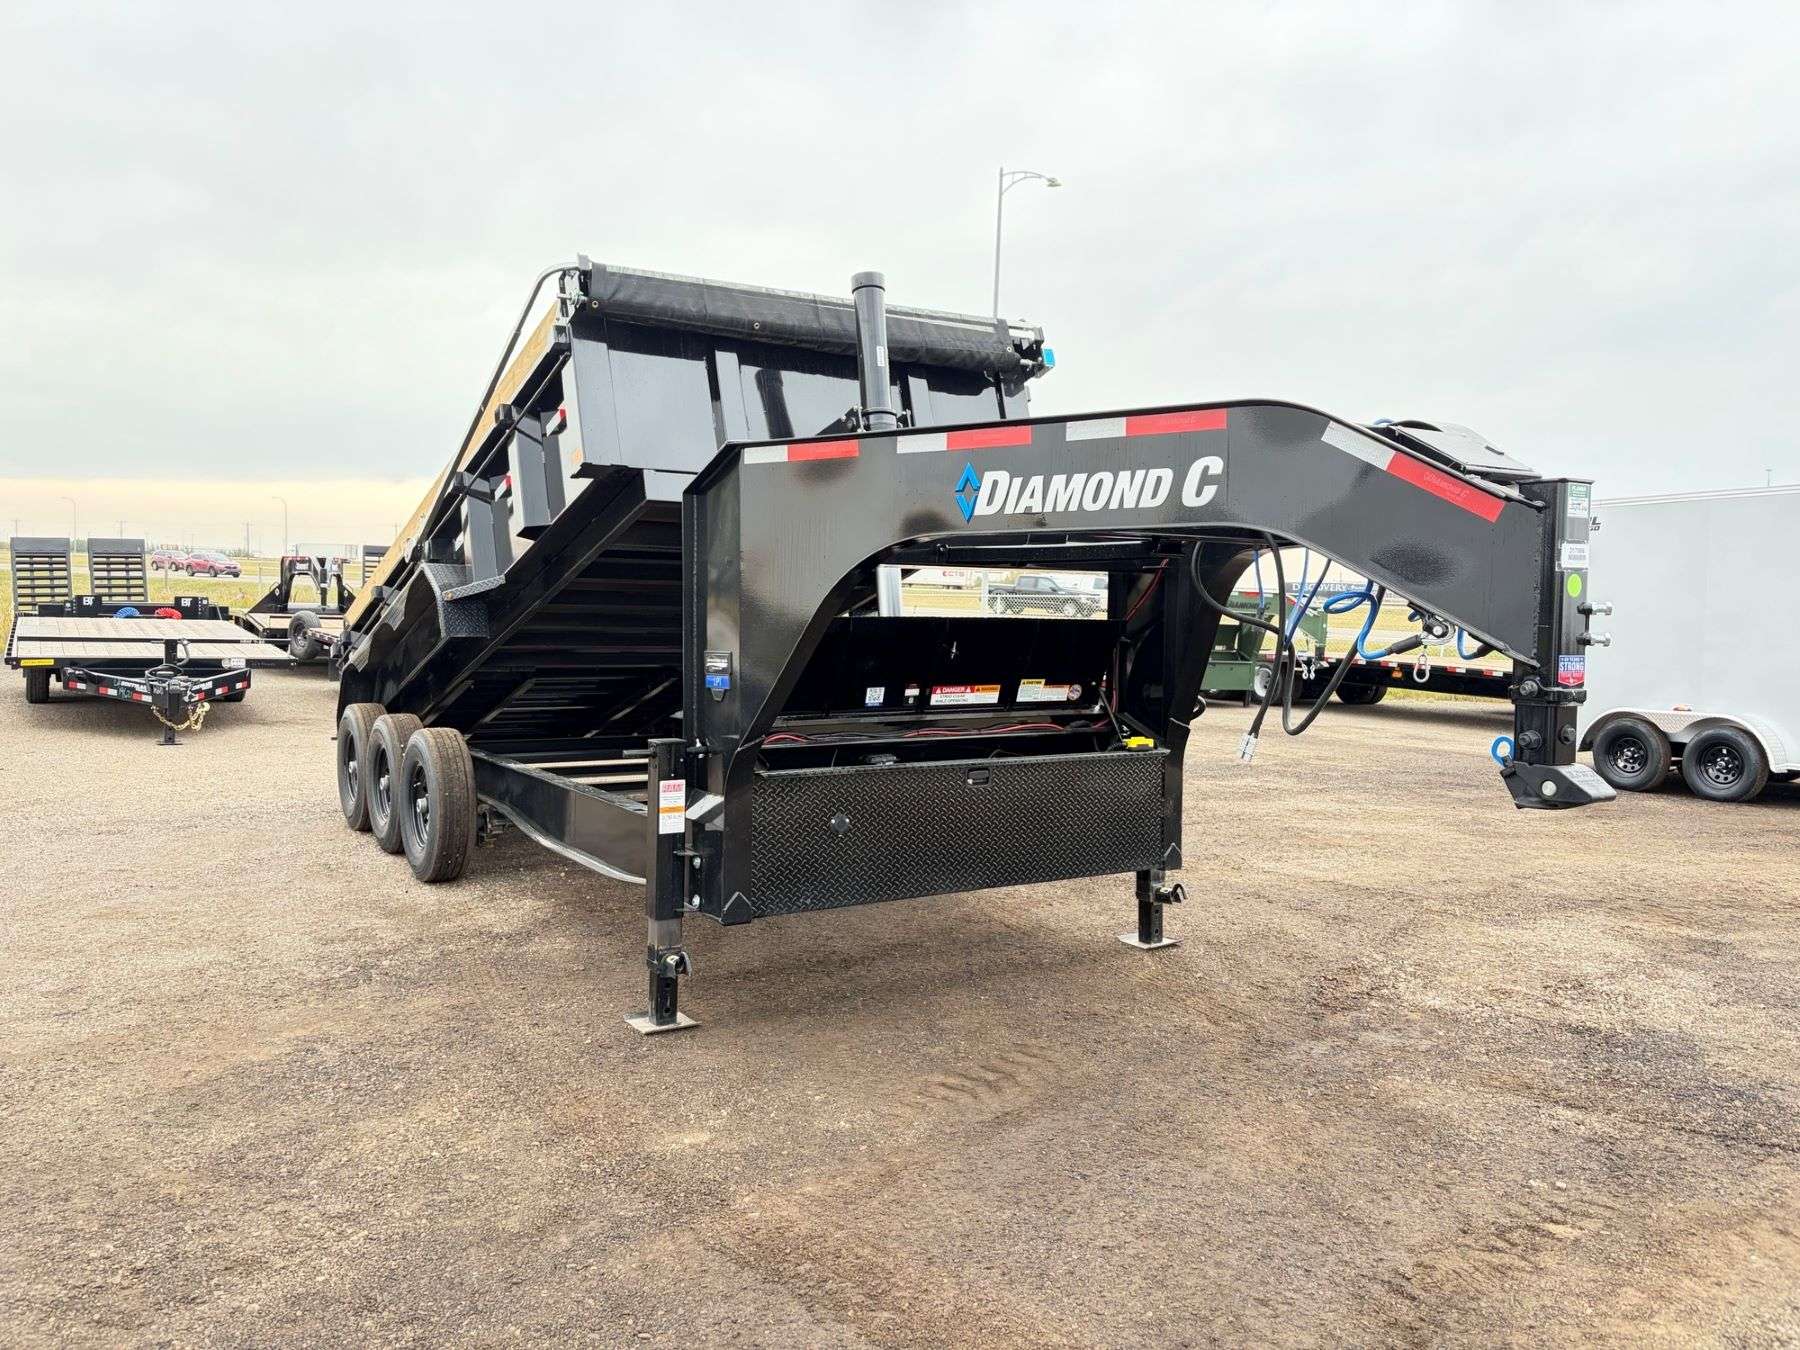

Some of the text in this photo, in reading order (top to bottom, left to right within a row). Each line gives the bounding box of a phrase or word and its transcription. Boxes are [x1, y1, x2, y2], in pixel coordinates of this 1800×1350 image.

[973, 456, 1224, 517] DIAMOND C
[1560, 661, 1585, 672] STRONG
